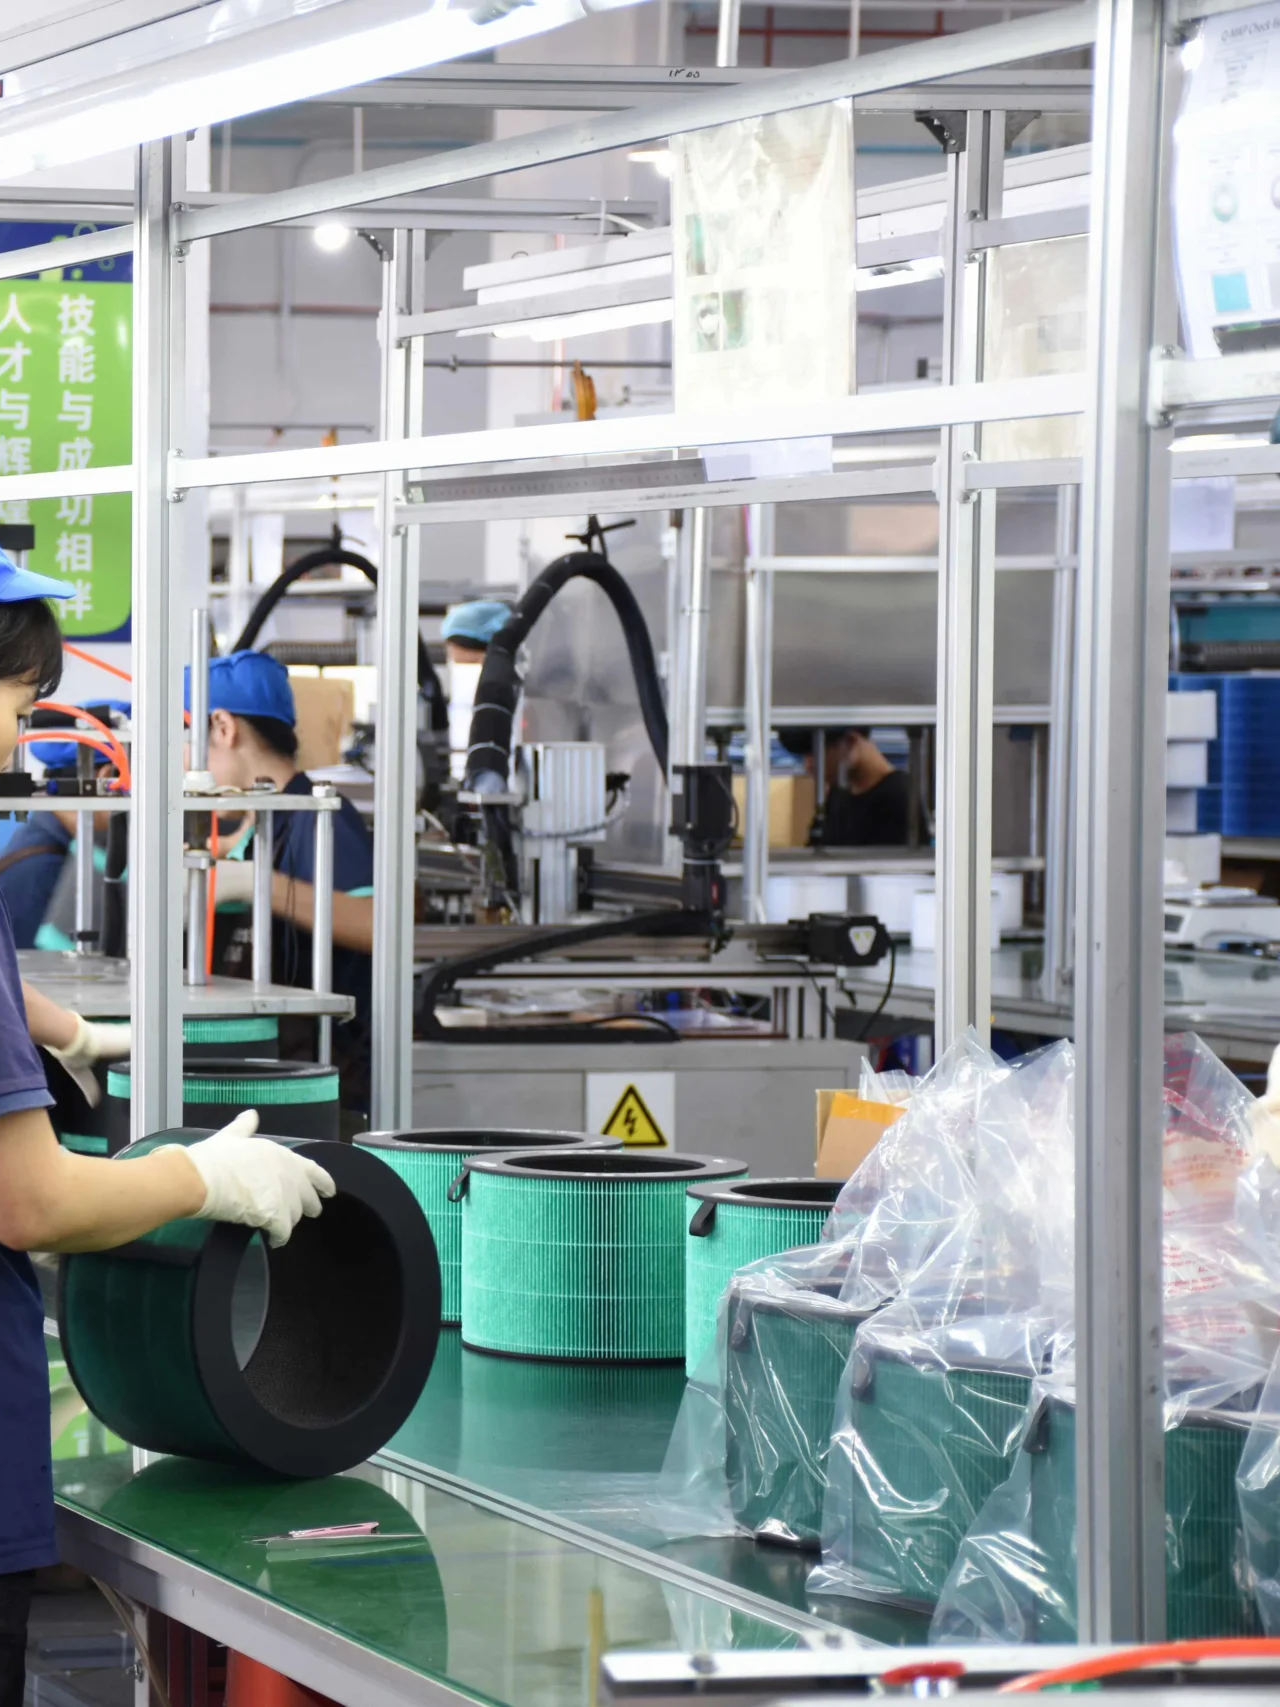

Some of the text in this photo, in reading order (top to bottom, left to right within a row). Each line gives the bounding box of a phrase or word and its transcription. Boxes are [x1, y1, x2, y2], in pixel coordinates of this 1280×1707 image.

[56, 294, 96, 620] 技能与成功相伴
